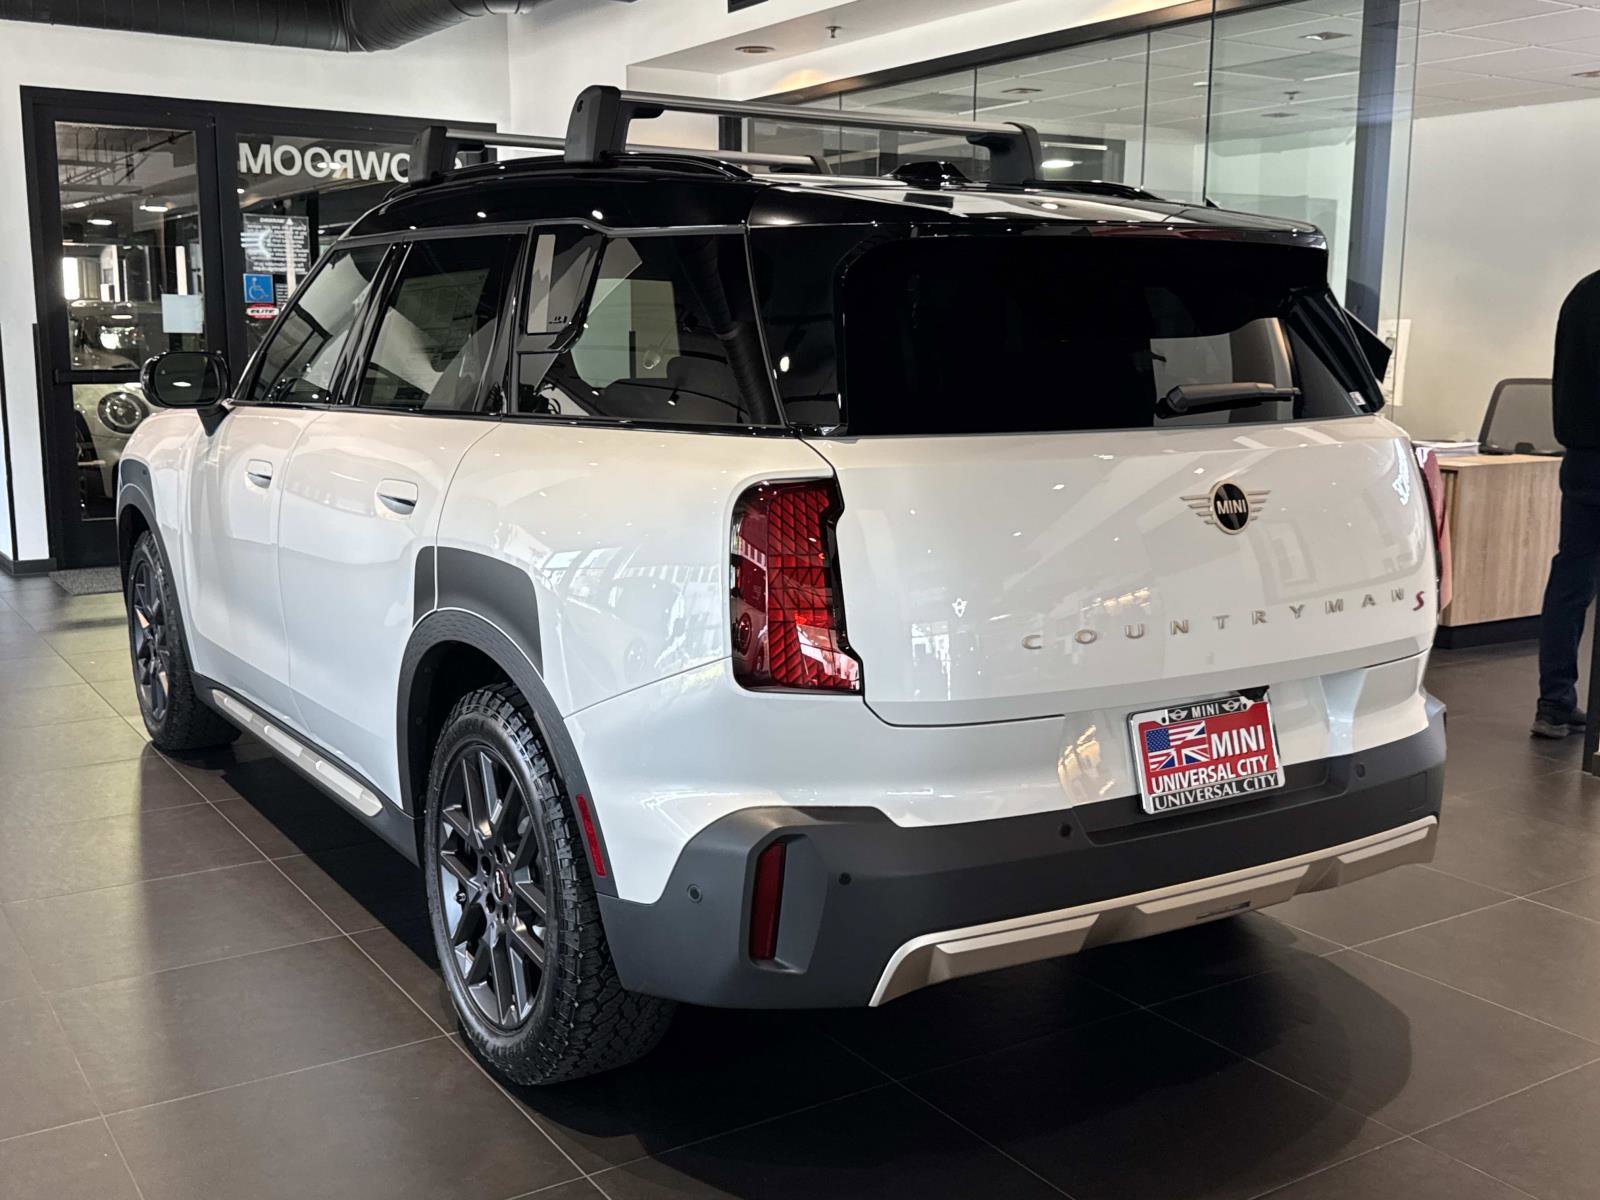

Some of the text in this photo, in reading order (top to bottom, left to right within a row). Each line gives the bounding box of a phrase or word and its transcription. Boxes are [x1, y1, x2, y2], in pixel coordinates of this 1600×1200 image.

[1216, 499, 1247, 514] MINI
[1021, 588, 1426, 651] COUNTRYMAN S
[1191, 703, 1219, 719] MINI
[1211, 726, 1265, 760] MINI
[1151, 754, 1269, 794] UNIVERSAL CITY
[1154, 774, 1277, 810] UNIVERSAL CITY
